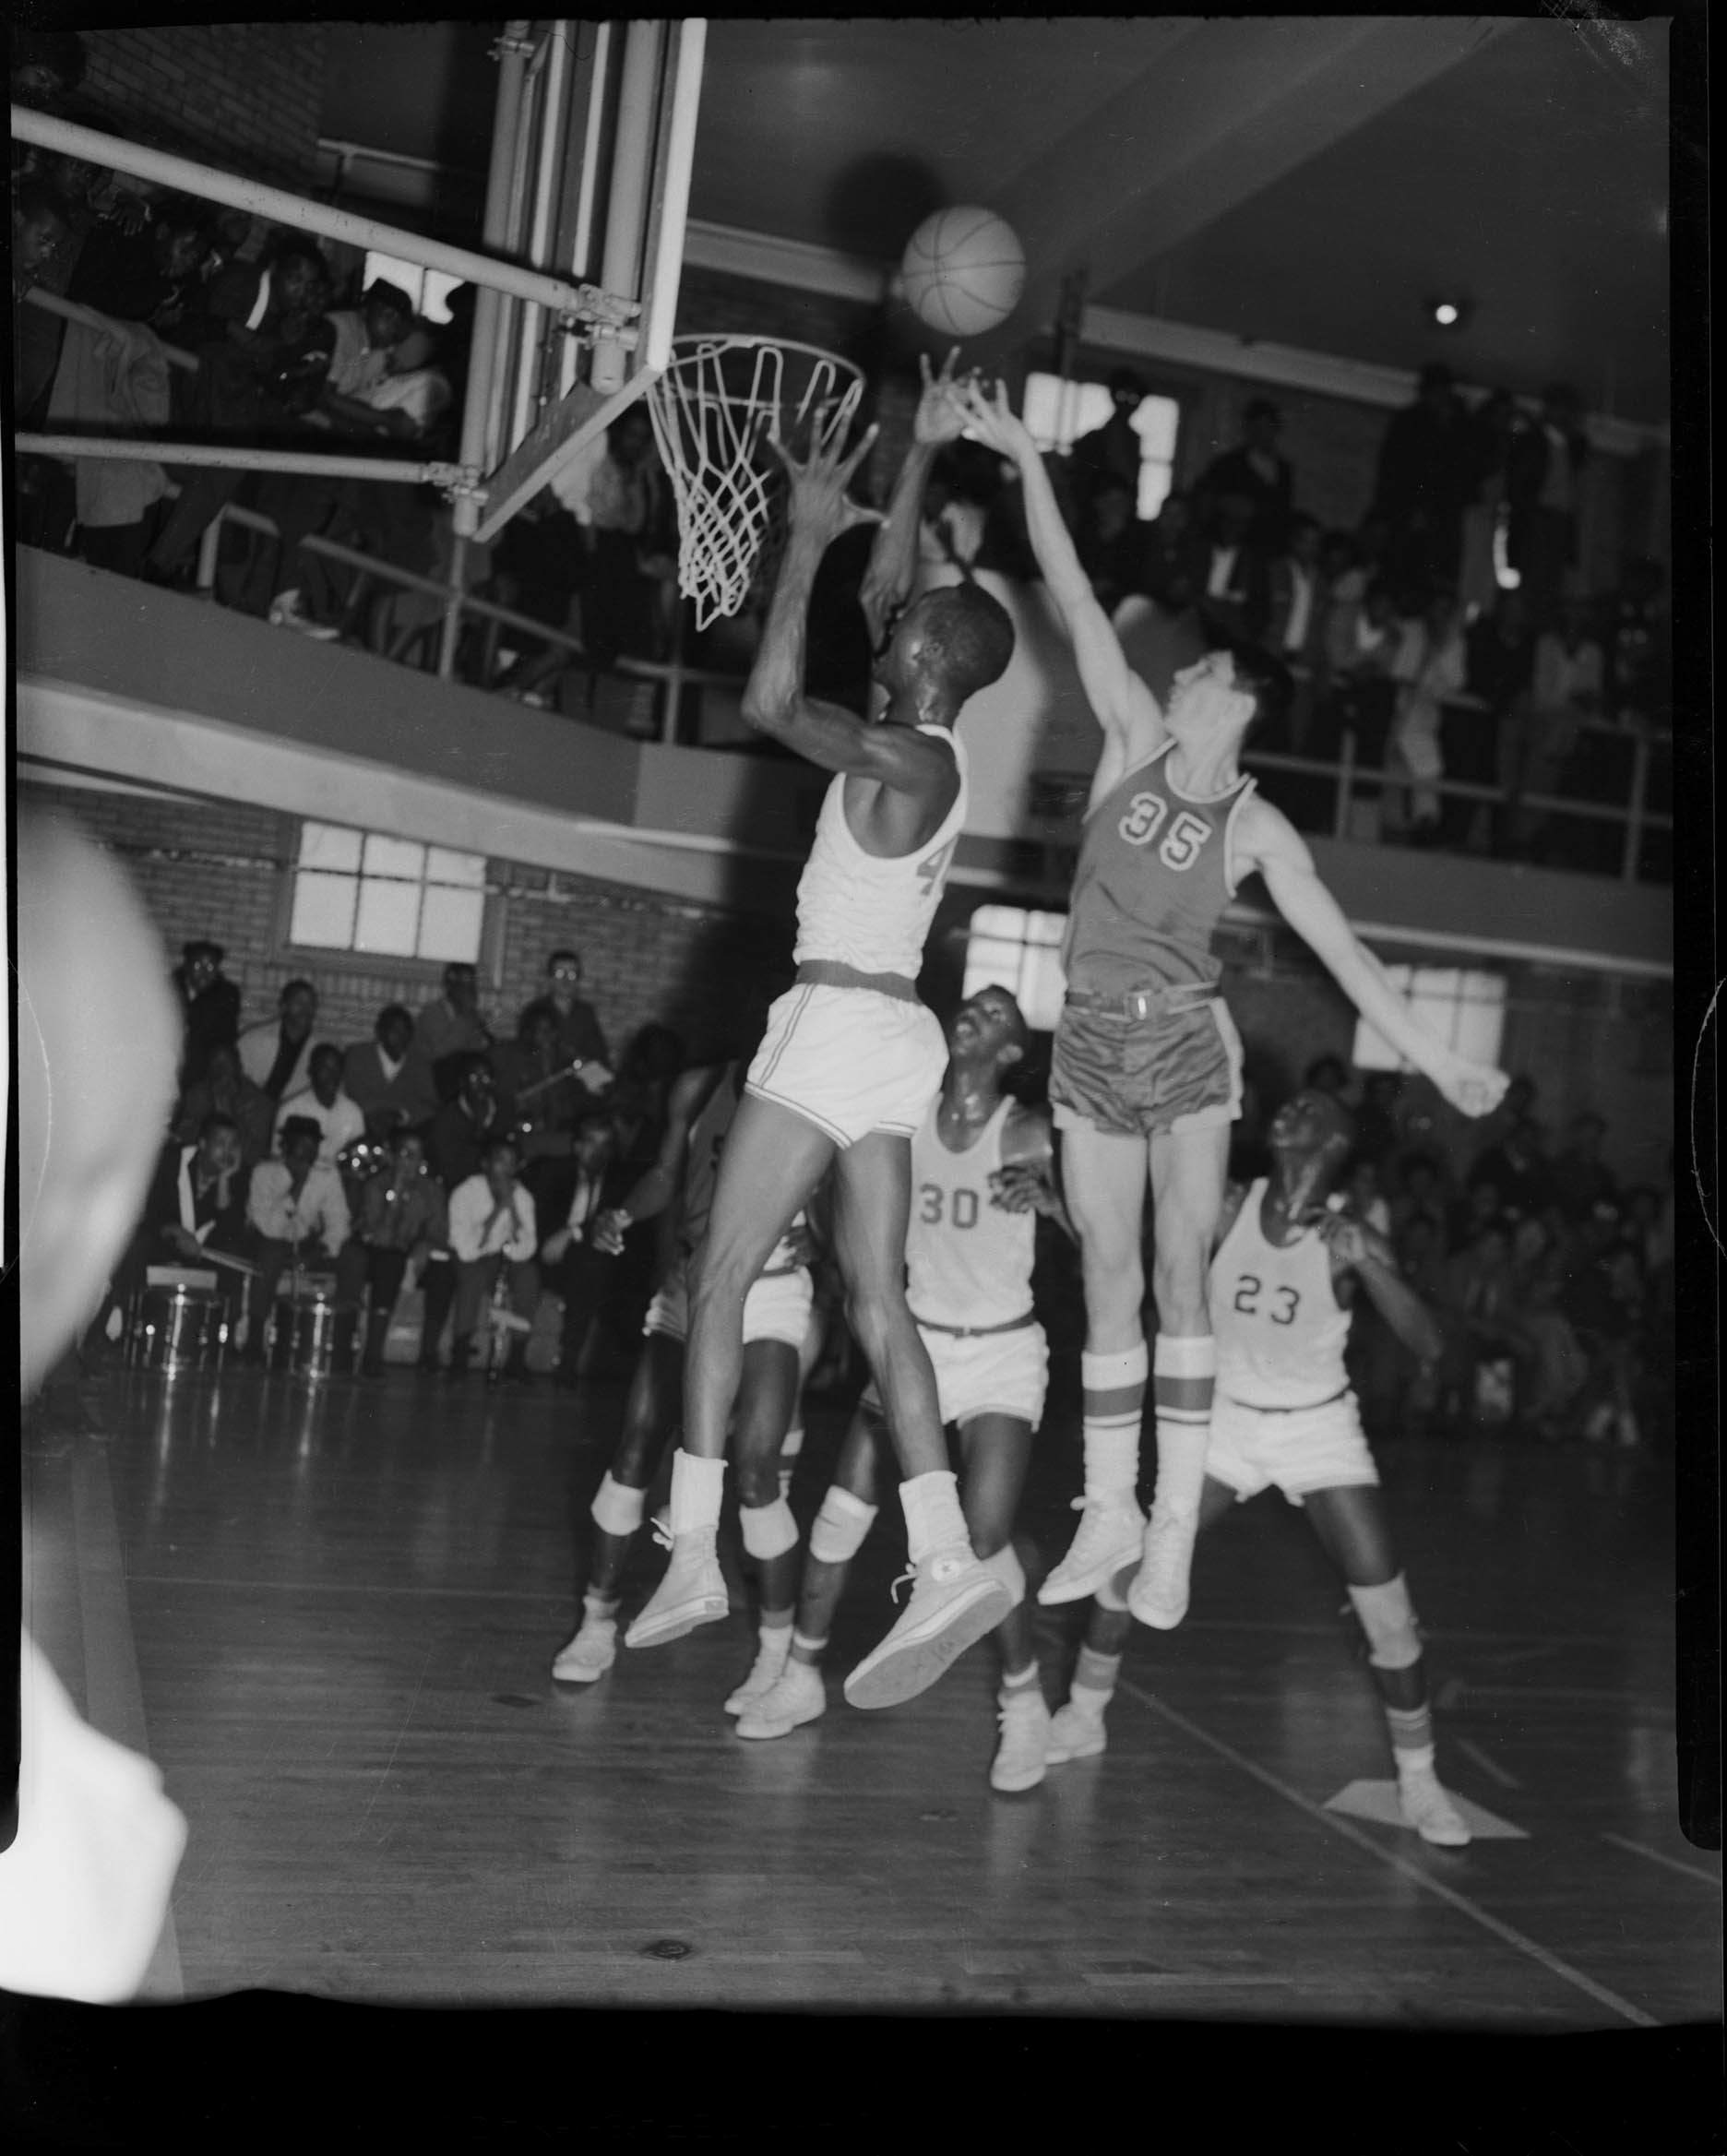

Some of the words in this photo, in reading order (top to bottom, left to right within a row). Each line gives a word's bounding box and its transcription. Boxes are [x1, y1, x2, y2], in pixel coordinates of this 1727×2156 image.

[1118, 792, 1212, 871] 35
[919, 1183, 978, 1230] 30
[1234, 1275, 1300, 1325] 23
